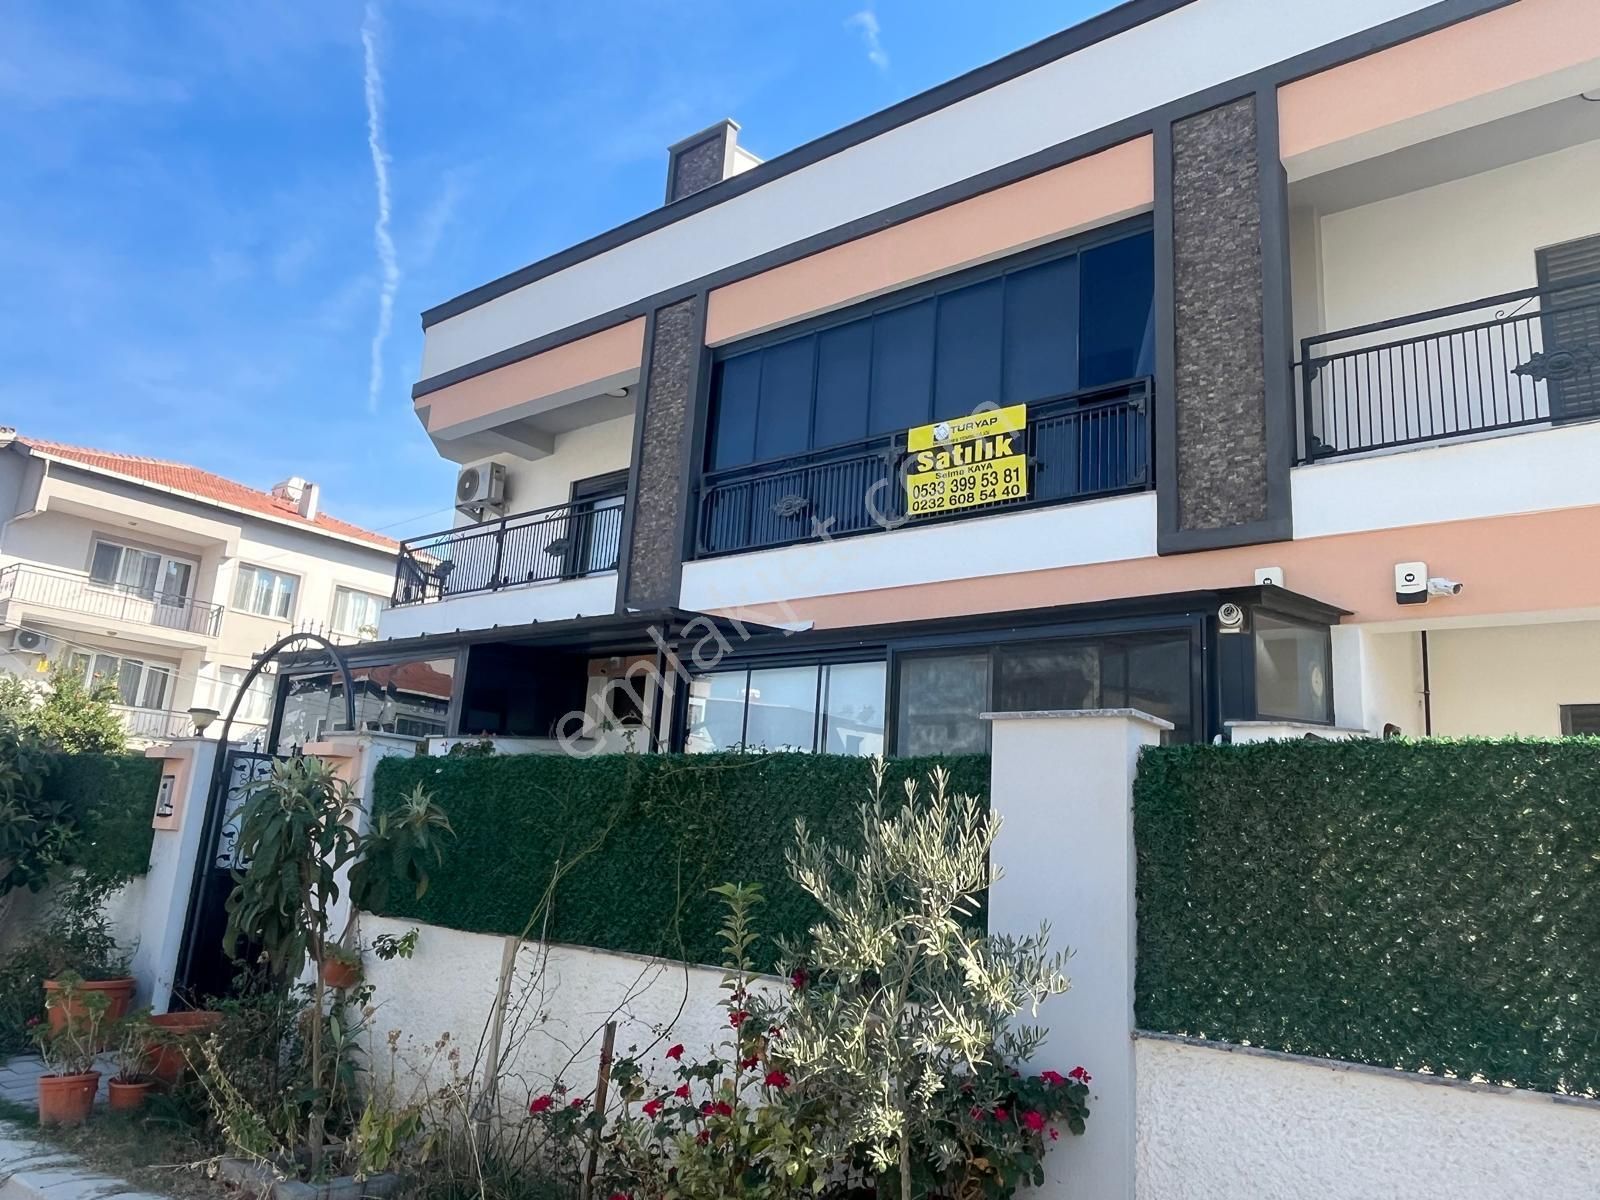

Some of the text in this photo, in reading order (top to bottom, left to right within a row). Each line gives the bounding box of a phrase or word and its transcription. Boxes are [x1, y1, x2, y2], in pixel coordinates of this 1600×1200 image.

[950, 417, 998, 433] TURYAP
[916, 435, 1013, 472] Satılık
[968, 463, 993, 473] KAYA
[913, 467, 1020, 499] 0533 399 53 81
[912, 484, 1020, 511] 0232 608 54 40
